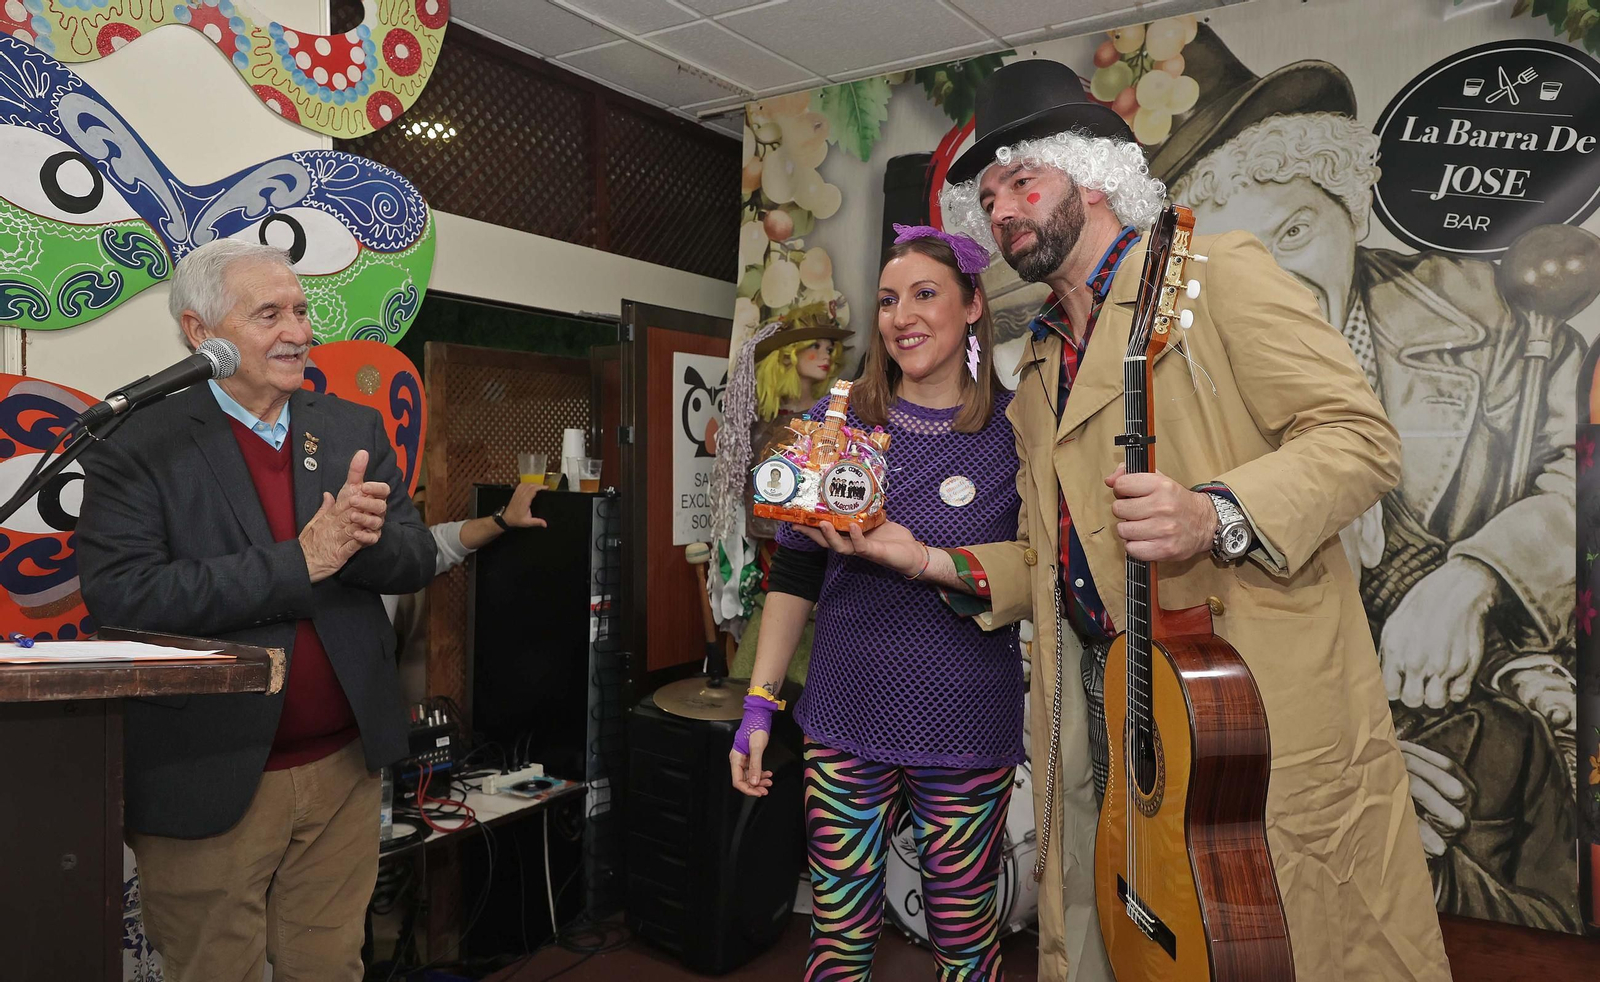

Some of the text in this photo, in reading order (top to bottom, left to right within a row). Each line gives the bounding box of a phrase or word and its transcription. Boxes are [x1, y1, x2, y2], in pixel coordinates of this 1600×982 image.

[1399, 116, 1597, 154] La Barra De
[1429, 163, 1531, 201] JOSE
[1443, 213, 1491, 232] BAR
[681, 493, 710, 509] EXCL
